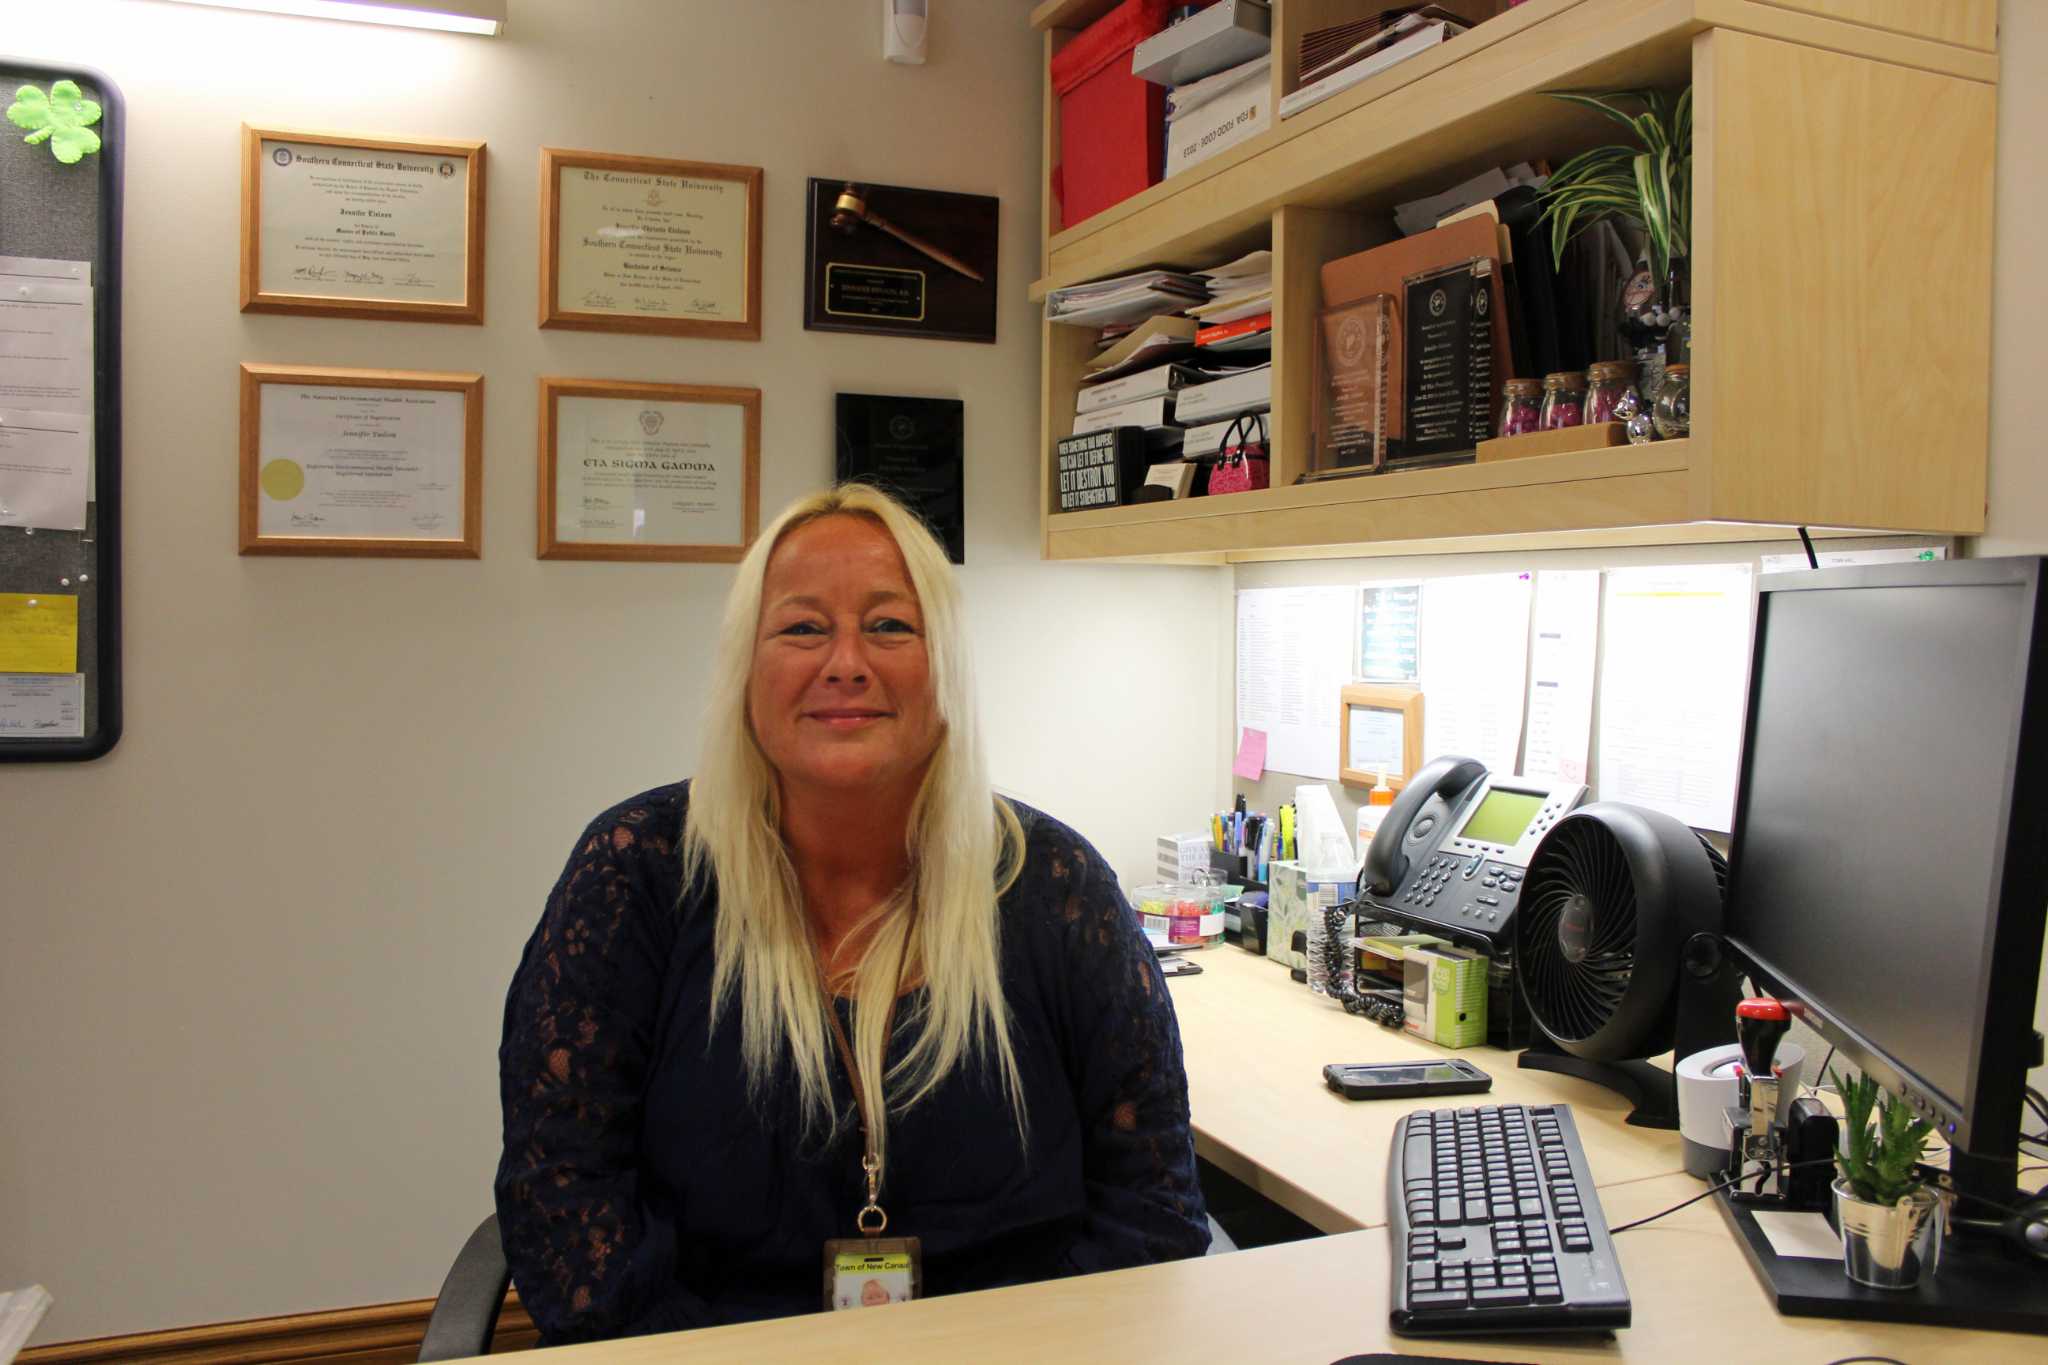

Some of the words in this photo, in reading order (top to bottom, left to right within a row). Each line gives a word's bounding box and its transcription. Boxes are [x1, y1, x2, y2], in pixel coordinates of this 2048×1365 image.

[1236, 111, 1248, 124] FDA
[1217, 119, 1234, 136] FOOD
[1201, 130, 1217, 148] CODE
[296, 155, 330, 166] Southern
[332, 156, 373, 169] Connecticut
[376, 161, 395, 171] State
[397, 163, 434, 174] University
[583, 171, 599, 181] The
[603, 173, 651, 185] Connecticut
[656, 177, 677, 188] State
[681, 180, 724, 194] University
[583, 237, 617, 249] Southern
[663, 242, 682, 254] State
[857, 1263, 865, 1271] of
